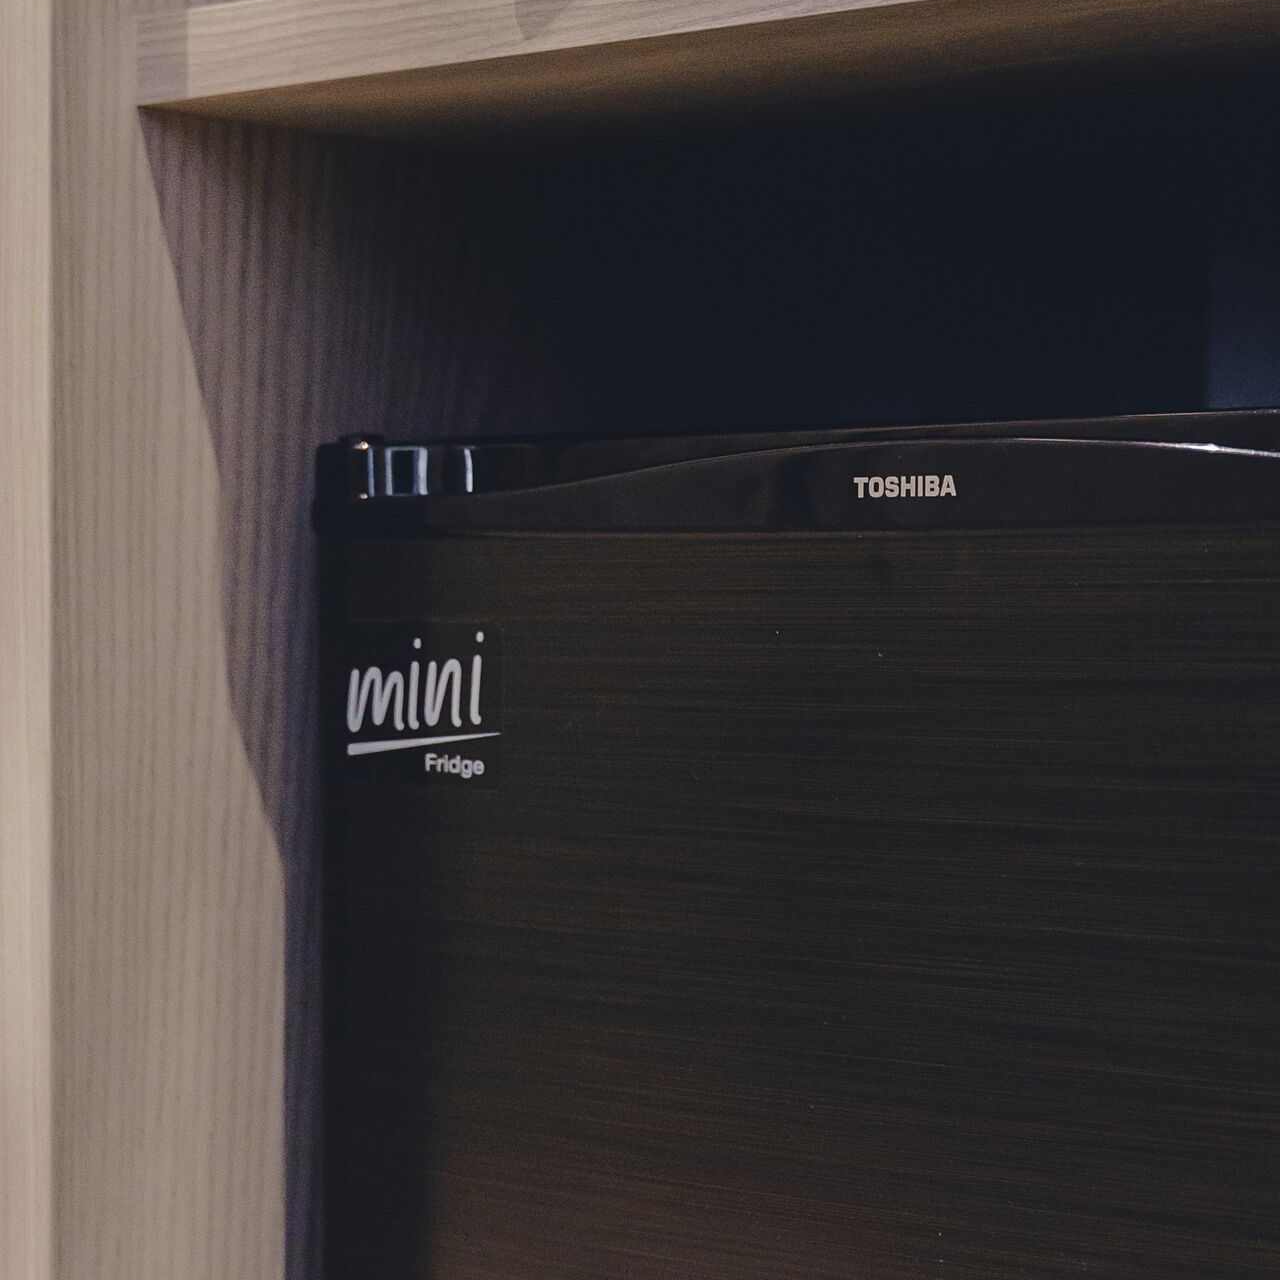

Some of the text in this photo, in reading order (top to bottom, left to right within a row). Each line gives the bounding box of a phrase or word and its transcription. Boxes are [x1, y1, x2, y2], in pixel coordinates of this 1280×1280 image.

[853, 475, 957, 498] TOSHIBA
[347, 631, 484, 732] mini
[424, 753, 485, 779] Fridge
